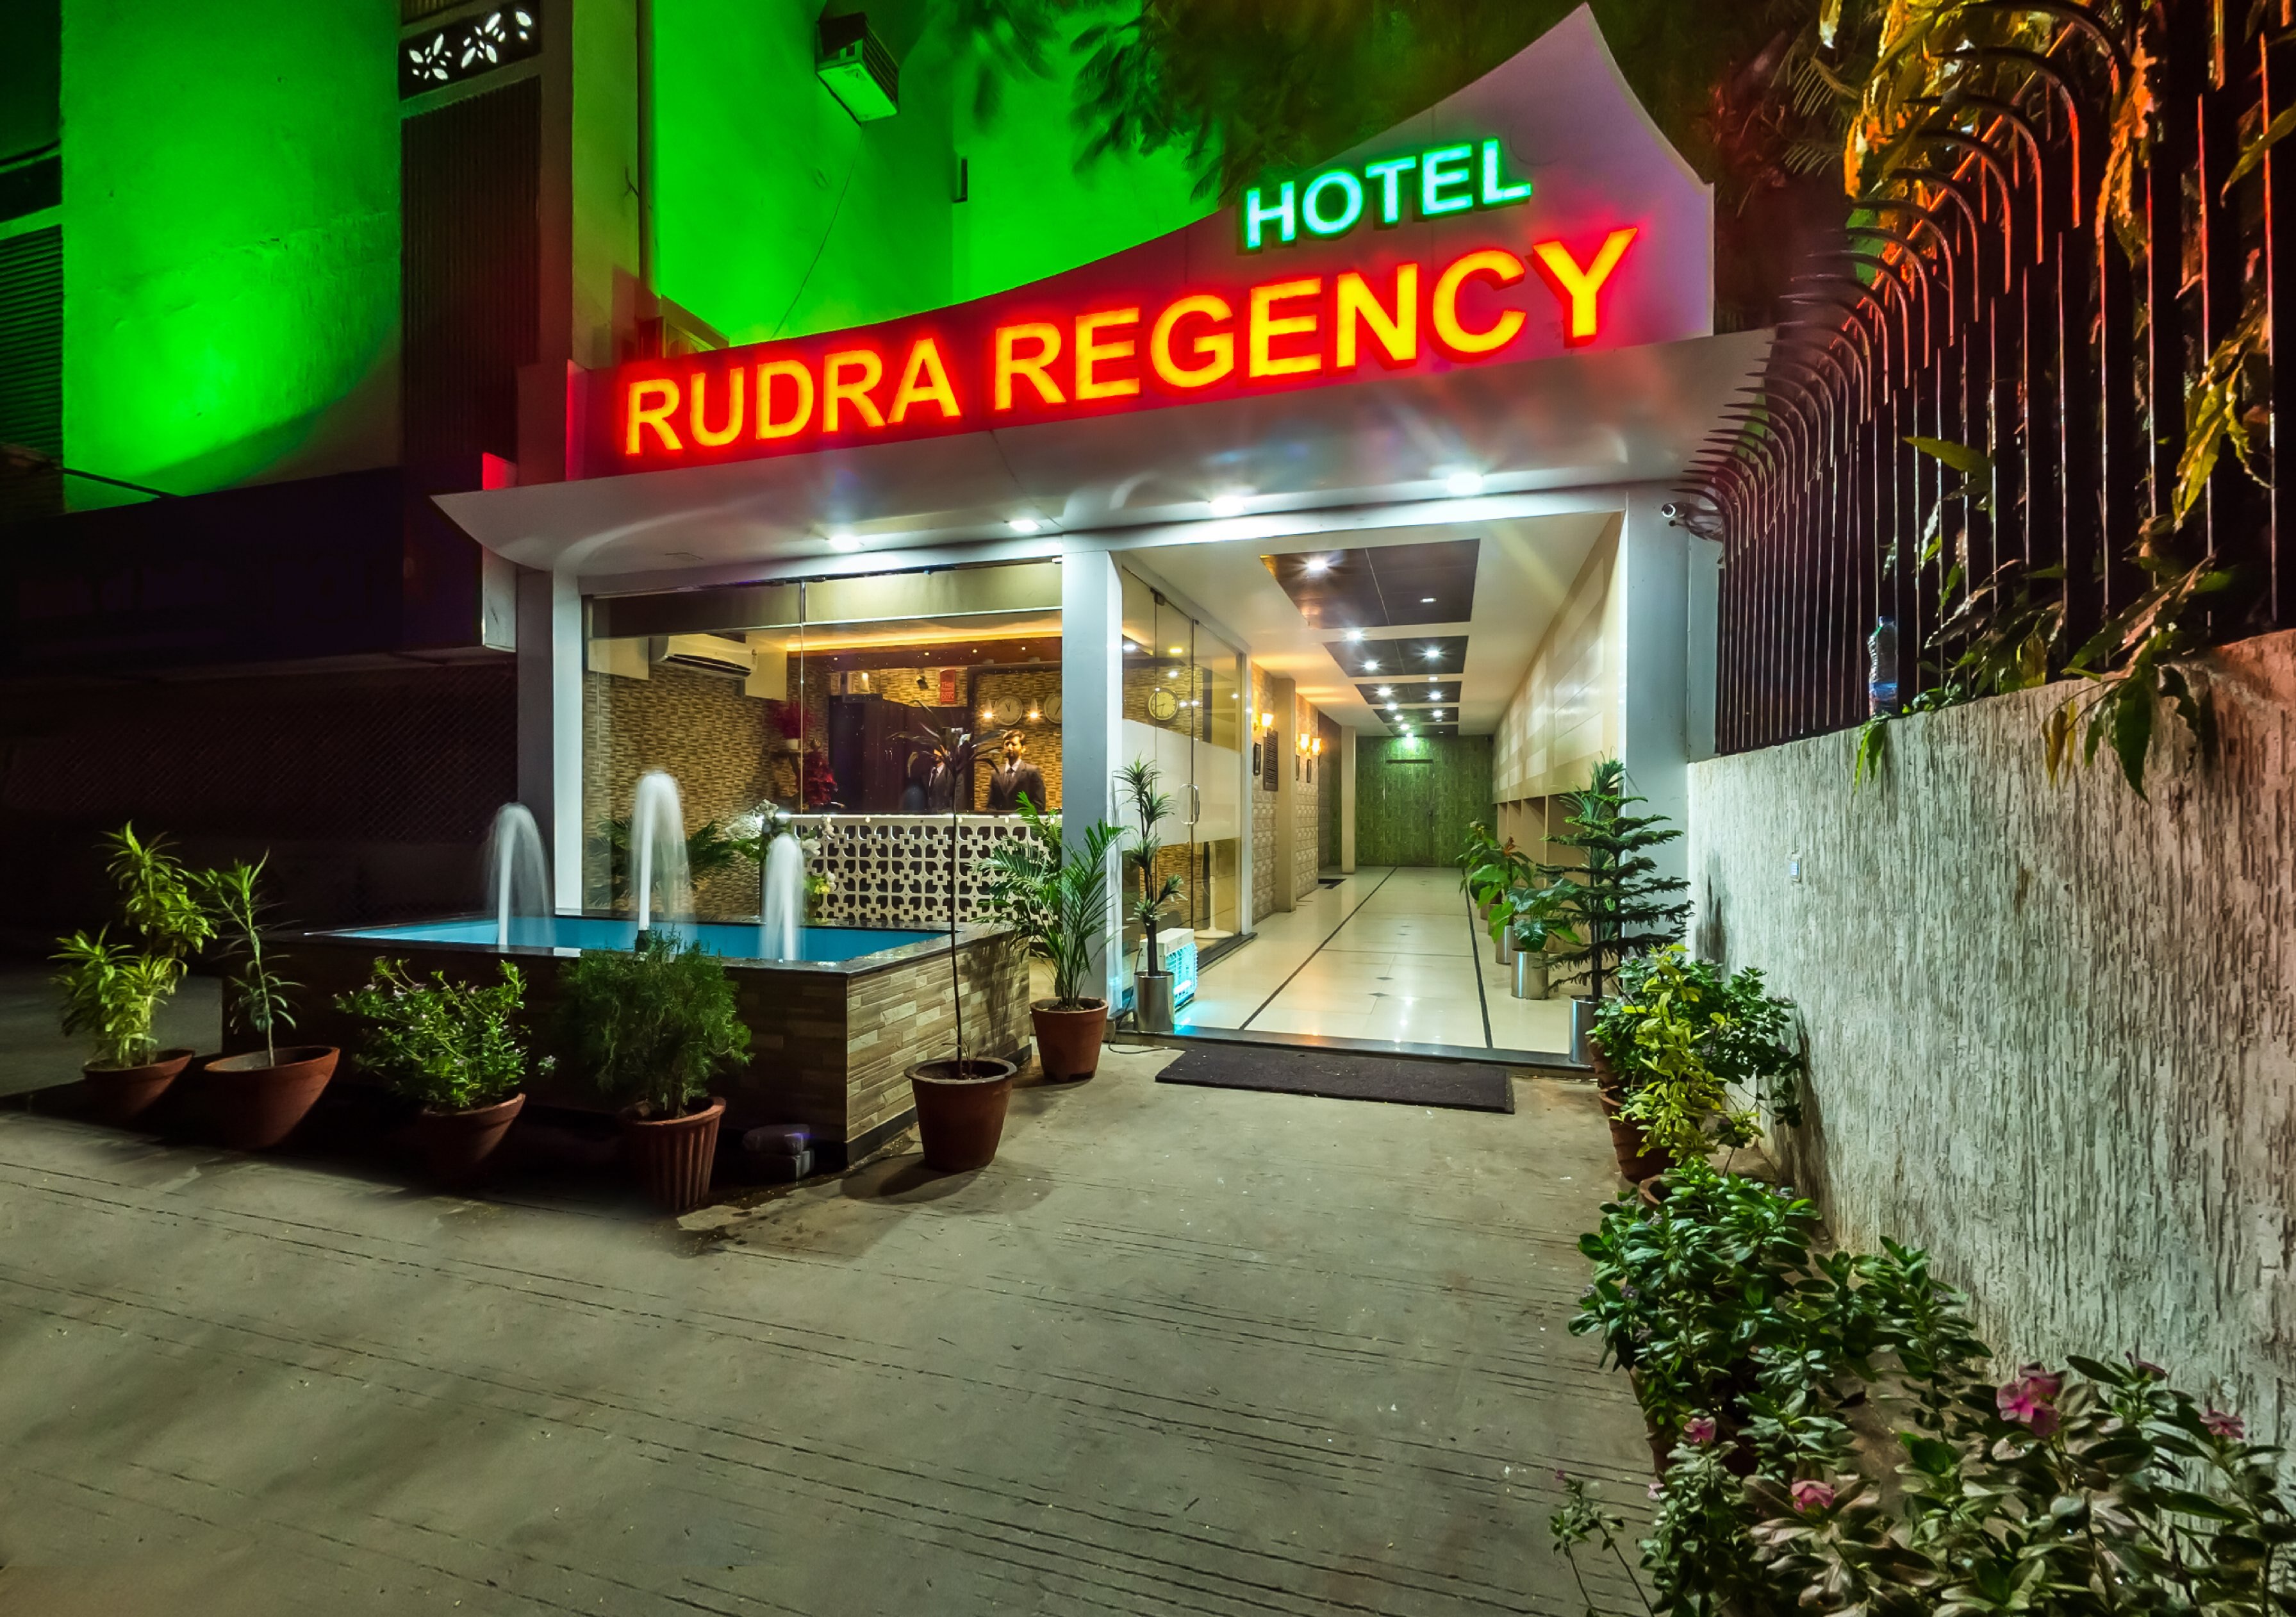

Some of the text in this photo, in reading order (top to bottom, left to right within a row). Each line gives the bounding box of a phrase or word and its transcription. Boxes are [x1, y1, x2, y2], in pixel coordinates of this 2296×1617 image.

[1244, 137, 1533, 250] HOTEL
[625, 228, 1635, 458] RUDRA REGENCY
